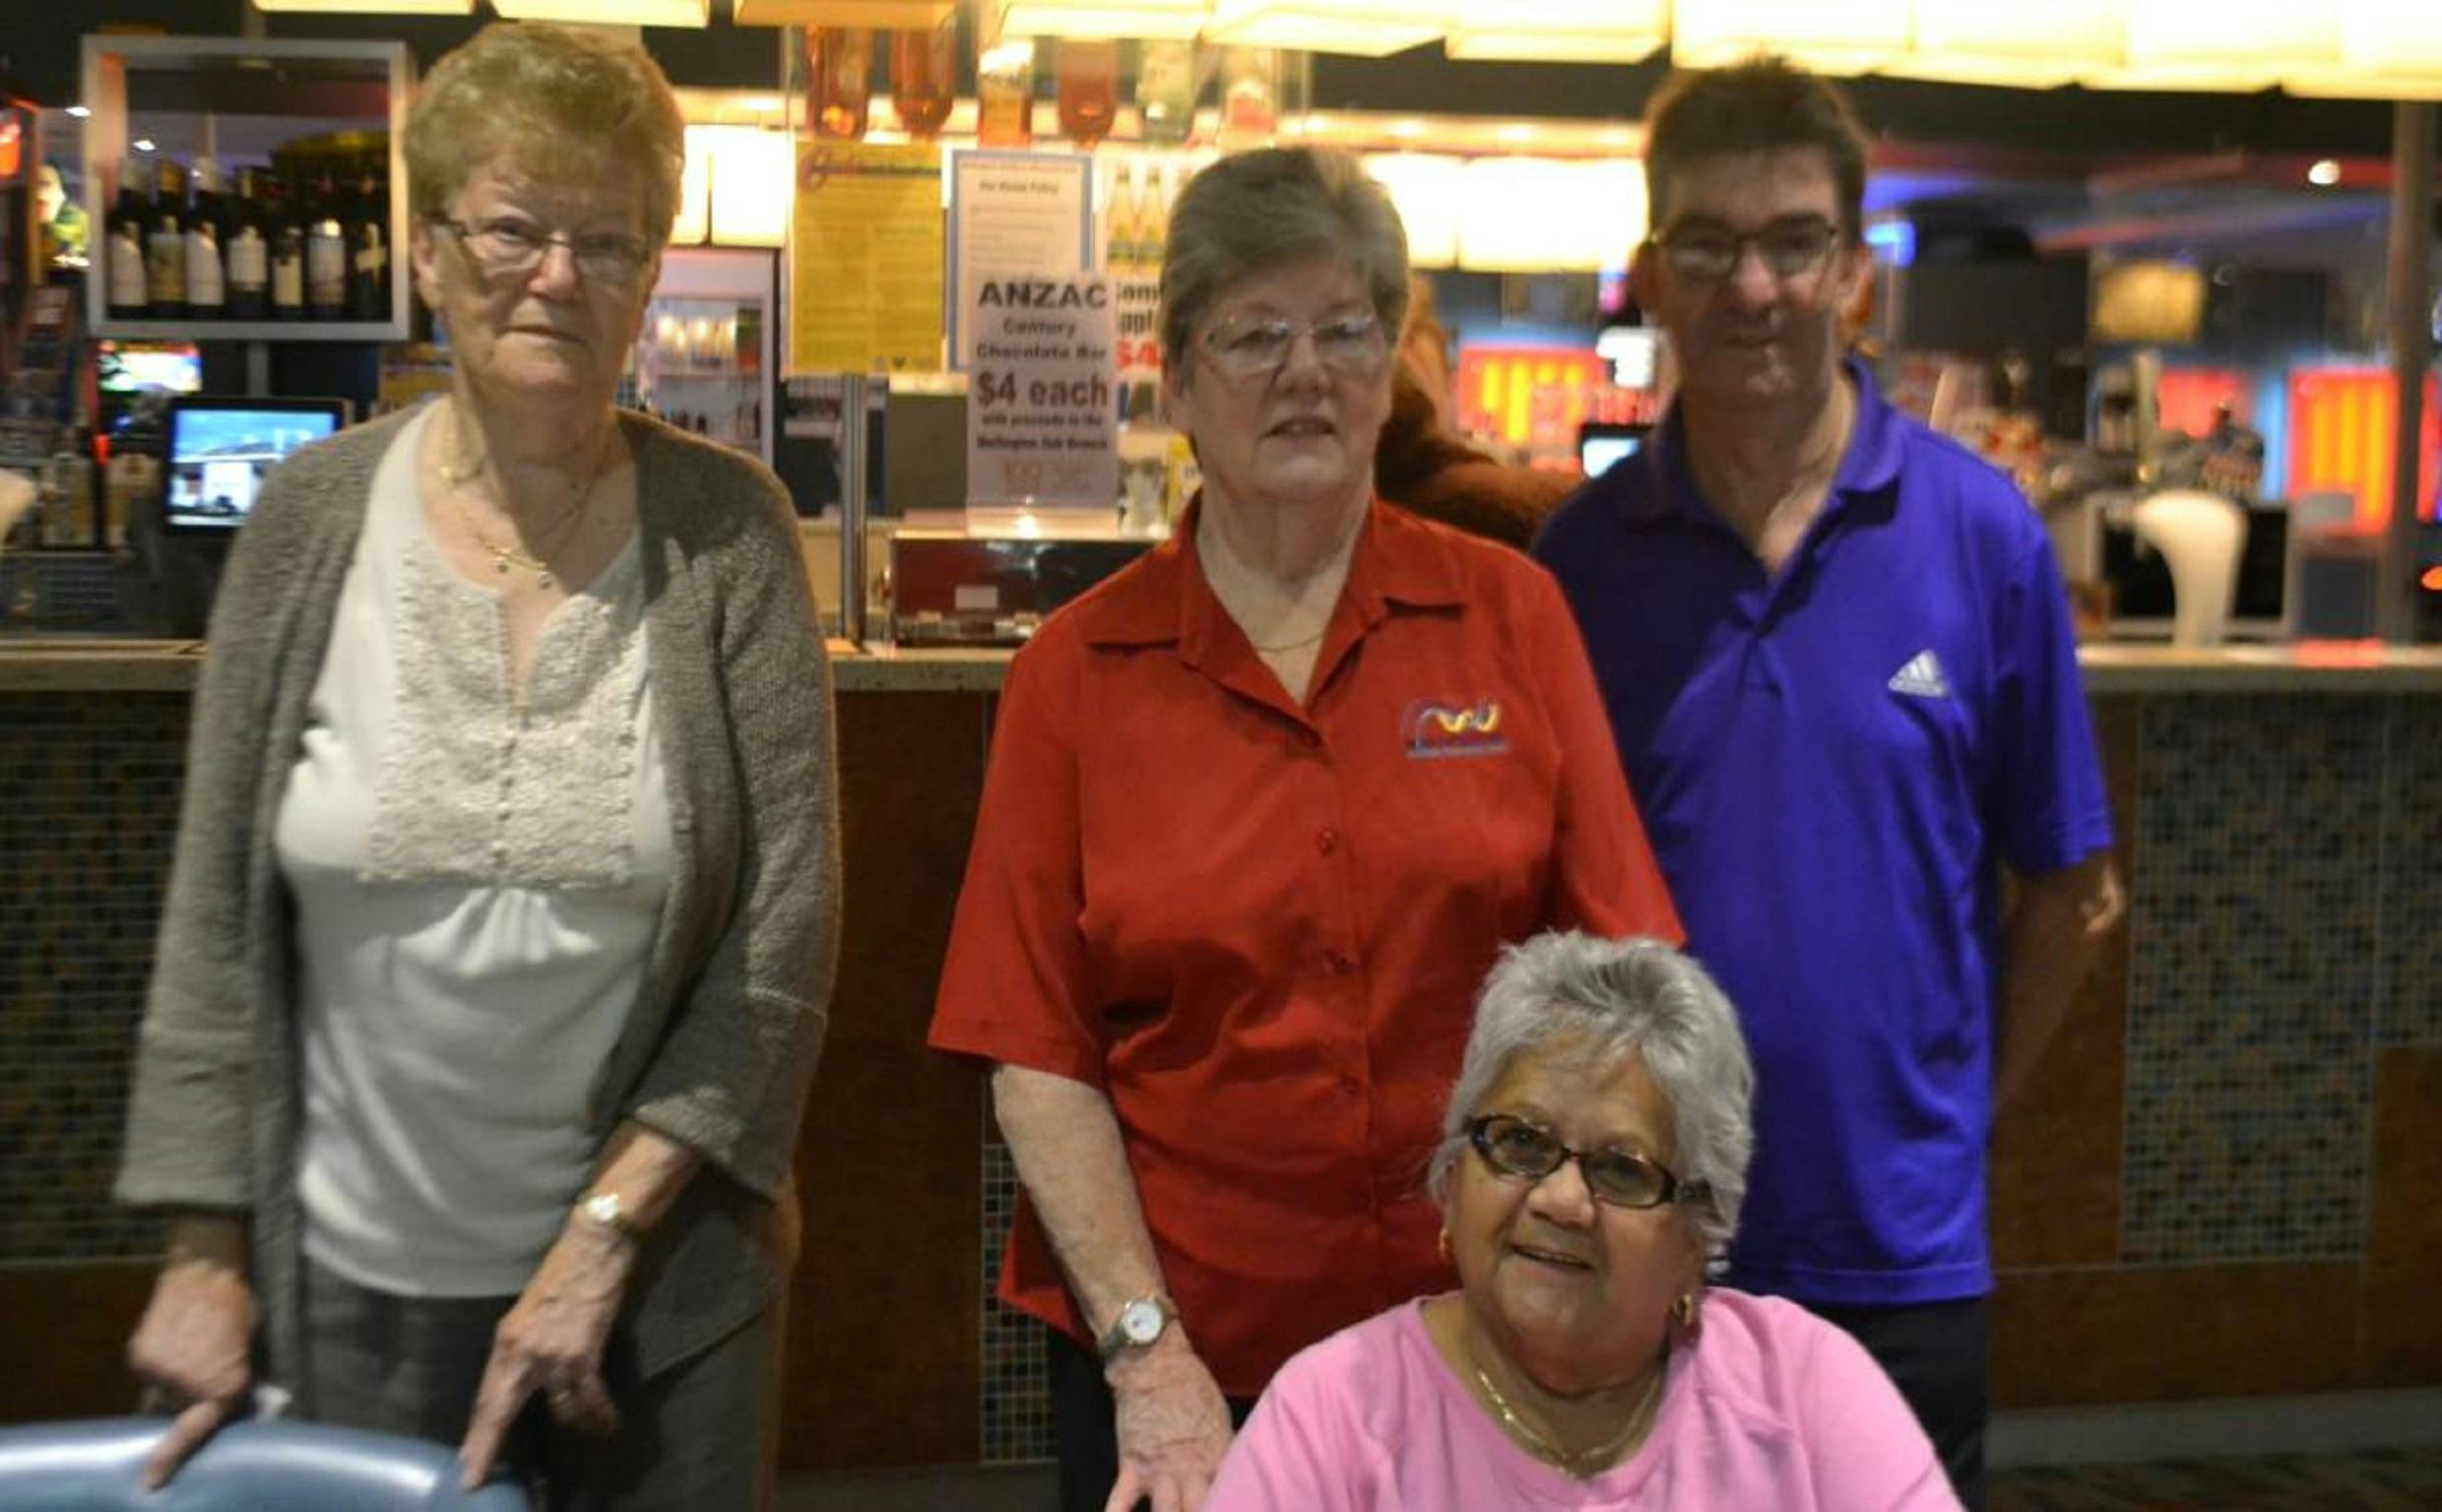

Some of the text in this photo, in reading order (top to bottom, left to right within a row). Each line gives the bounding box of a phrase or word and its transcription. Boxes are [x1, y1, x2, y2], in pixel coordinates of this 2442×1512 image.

[978, 282, 1107, 308] ANZAC
[977, 343, 1069, 358] Chocolate
[977, 372, 1108, 408] $4 each
